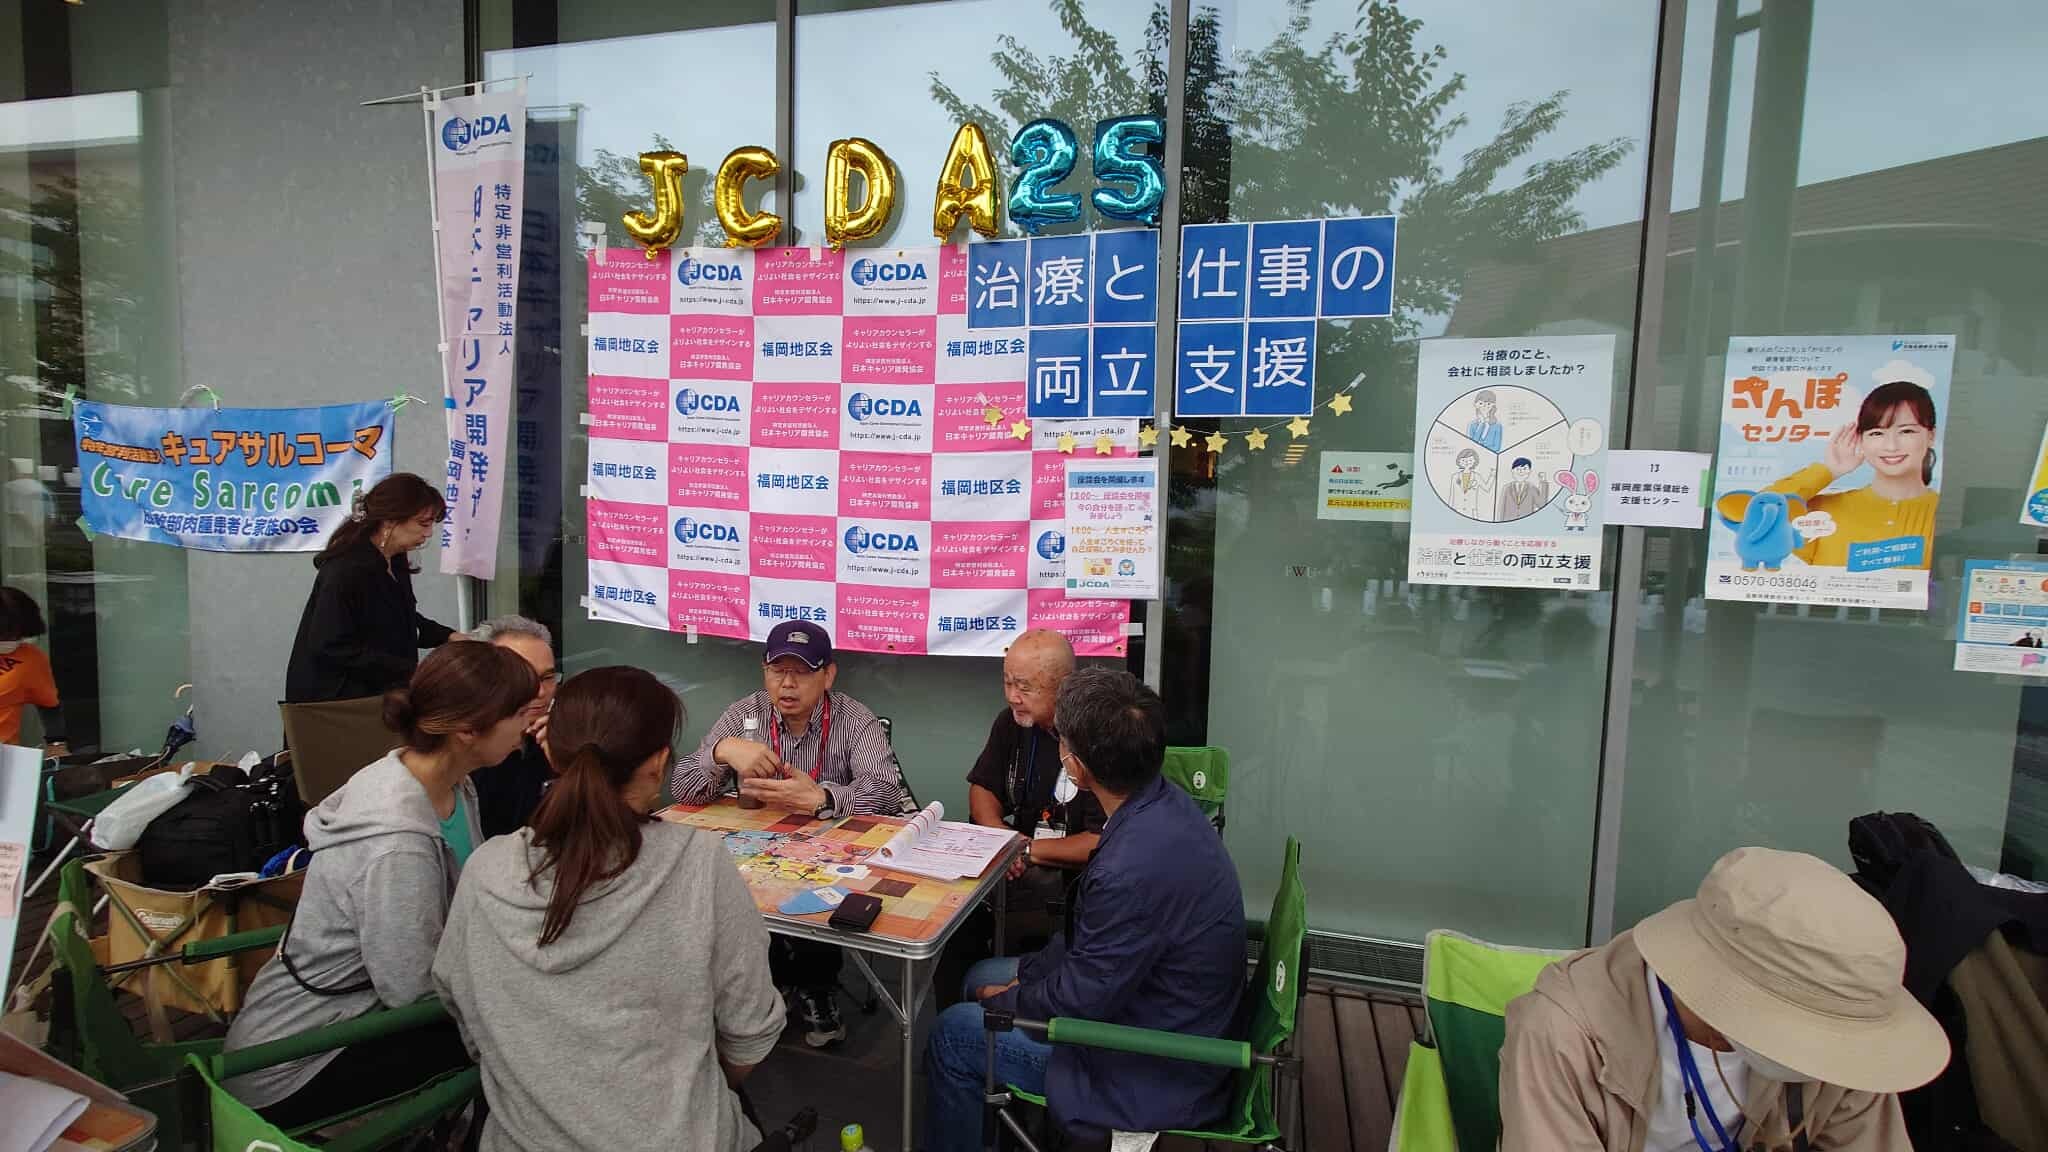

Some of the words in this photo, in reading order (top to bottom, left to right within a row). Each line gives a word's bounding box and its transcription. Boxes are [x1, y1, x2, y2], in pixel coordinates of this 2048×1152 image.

[459, 113, 511, 144] JCDA
[494, 184, 512, 355] 特定非営利活動法人
[690, 264, 743, 281] JCDA
[869, 263, 928, 280] JCDA
[975, 255, 1144, 309] 治療と
[1188, 244, 1384, 299] 仕事の
[593, 337, 659, 354] 福岡地区会
[762, 342, 833, 357] 福岡地区会
[946, 338, 1025, 357] 福岡地区会
[1482, 349, 1552, 361] 治療のこと、
[1035, 347, 1148, 405] 両立
[1185, 337, 1307, 394] 支援
[1448, 364, 1585, 378] 会社に相談しましたか？
[688, 395, 740, 412] JCDA
[1732, 372, 1848, 419] さんぽ
[862, 398, 922, 418] JCDA
[1742, 422, 1830, 443] センター
[162, 425, 383, 466] キュアサルコーマ
[593, 463, 656, 480] 福岡地区会
[757, 474, 829, 490] 福岡地区会
[941, 479, 1021, 495] 福岡地区会
[1620, 496, 1680, 505] 支援センター
[687, 523, 740, 542] JCDA
[860, 533, 919, 551] JCDA
[1734, 576, 1817, 589] 0570-038046
[594, 585, 656, 605] 福岡地区会
[758, 602, 827, 621] 福岡地区会
[938, 616, 1016, 631] 福岡地区会
